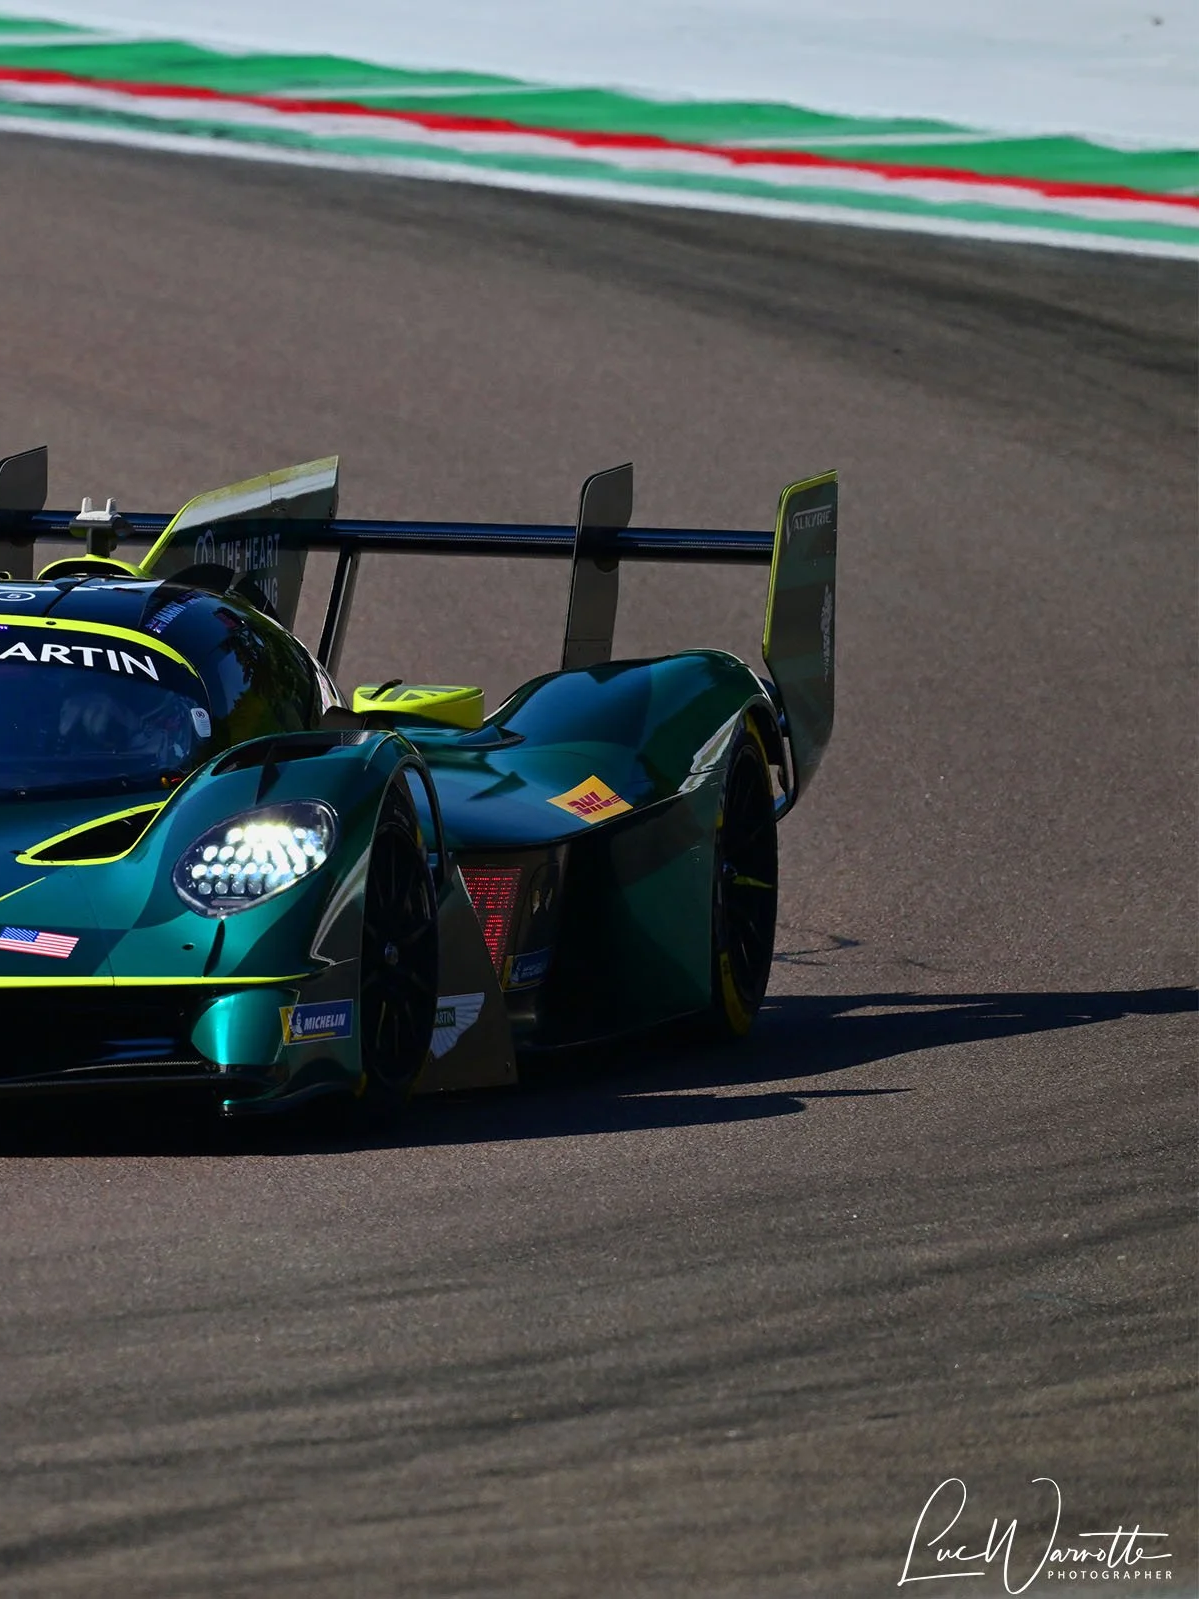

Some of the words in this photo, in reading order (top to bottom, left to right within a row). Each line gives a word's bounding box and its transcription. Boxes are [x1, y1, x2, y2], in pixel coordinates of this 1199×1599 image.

[220, 540, 242, 573] THE
[244, 533, 280, 572] HEART
[303, 1013, 347, 1031] MICHELIN
[434, 1010, 455, 1025] ARTIN
